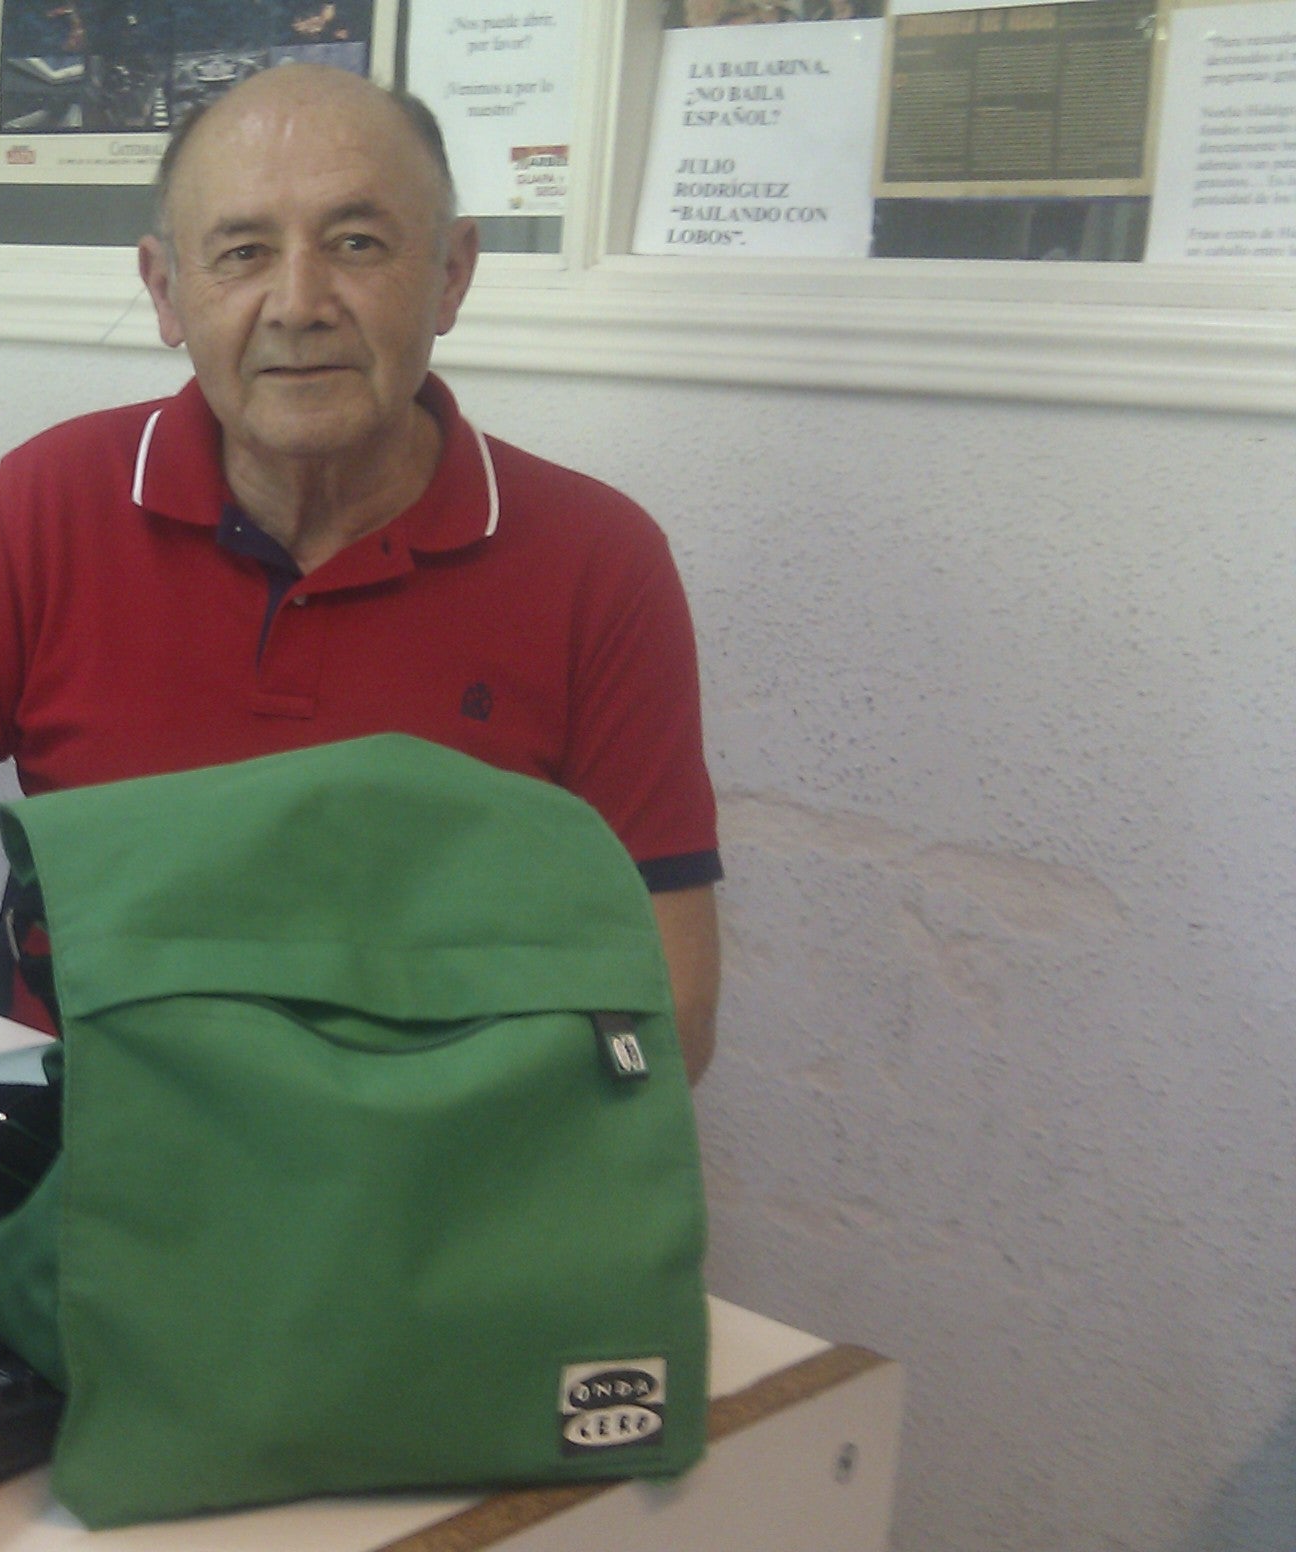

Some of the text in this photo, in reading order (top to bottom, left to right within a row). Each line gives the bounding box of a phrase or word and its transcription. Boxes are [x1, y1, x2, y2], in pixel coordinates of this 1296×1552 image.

[688, 64, 715, 79] LA
[727, 84, 785, 102] BAILA
[682, 105, 782, 127] ESPAÑOL?
[676, 158, 736, 175] JULIO
[673, 177, 791, 199] RODRÍGUEZ
[784, 206, 830, 223] CON
